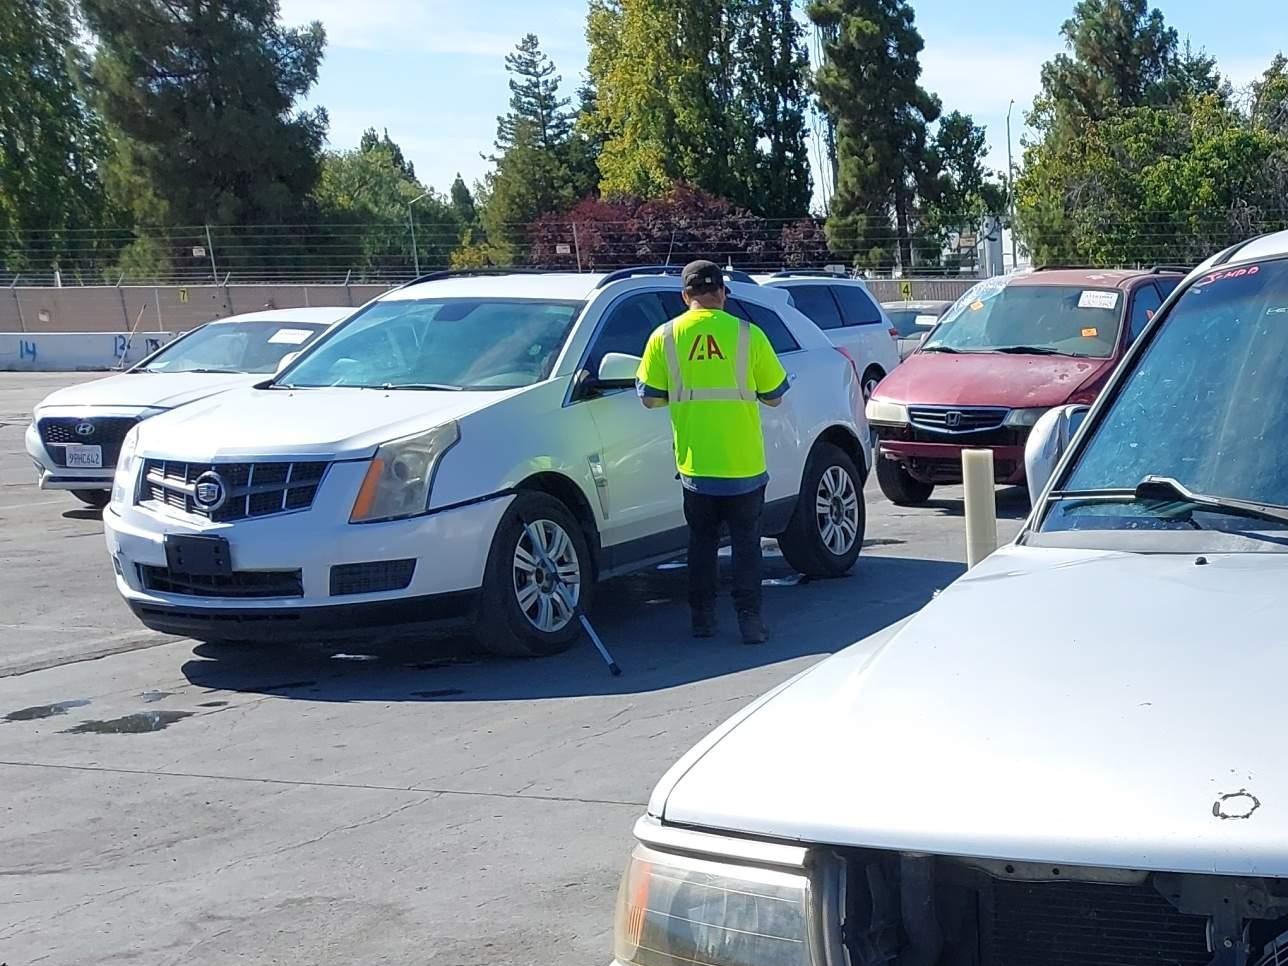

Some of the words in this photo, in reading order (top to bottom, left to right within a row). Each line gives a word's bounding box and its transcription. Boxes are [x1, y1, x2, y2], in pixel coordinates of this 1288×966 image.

[179, 288, 186, 301] 7
[902, 283, 910, 297] 4
[19, 340, 37, 362] 14
